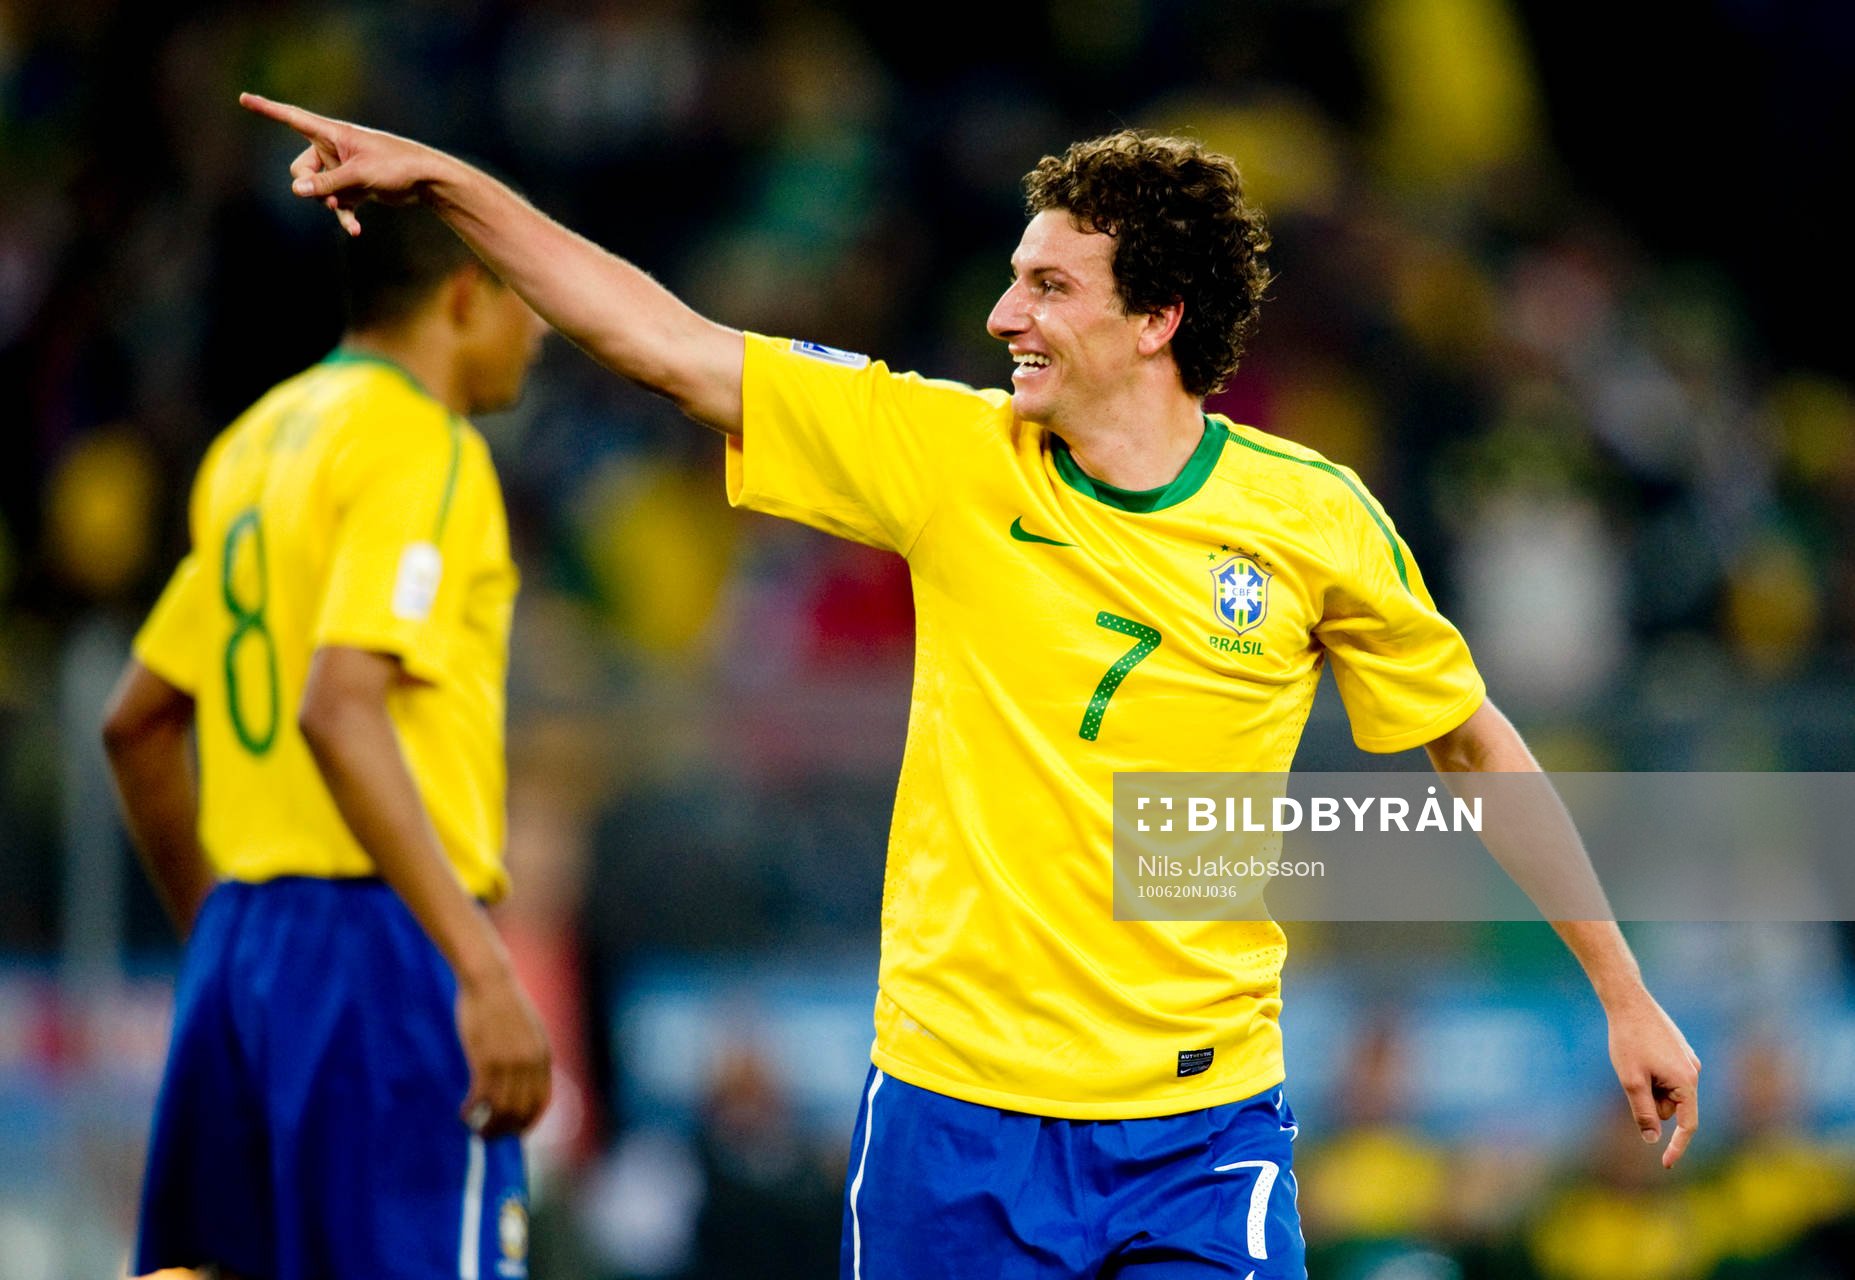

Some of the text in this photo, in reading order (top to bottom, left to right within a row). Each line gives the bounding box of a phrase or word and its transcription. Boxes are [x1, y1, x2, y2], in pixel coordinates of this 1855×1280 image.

[223, 508, 279, 755] 8
[1231, 587, 1251, 597] CBF
[1079, 611, 1162, 741] 7
[1209, 636, 1264, 656] BRASIL
[1214, 1160, 1280, 1260] 7
